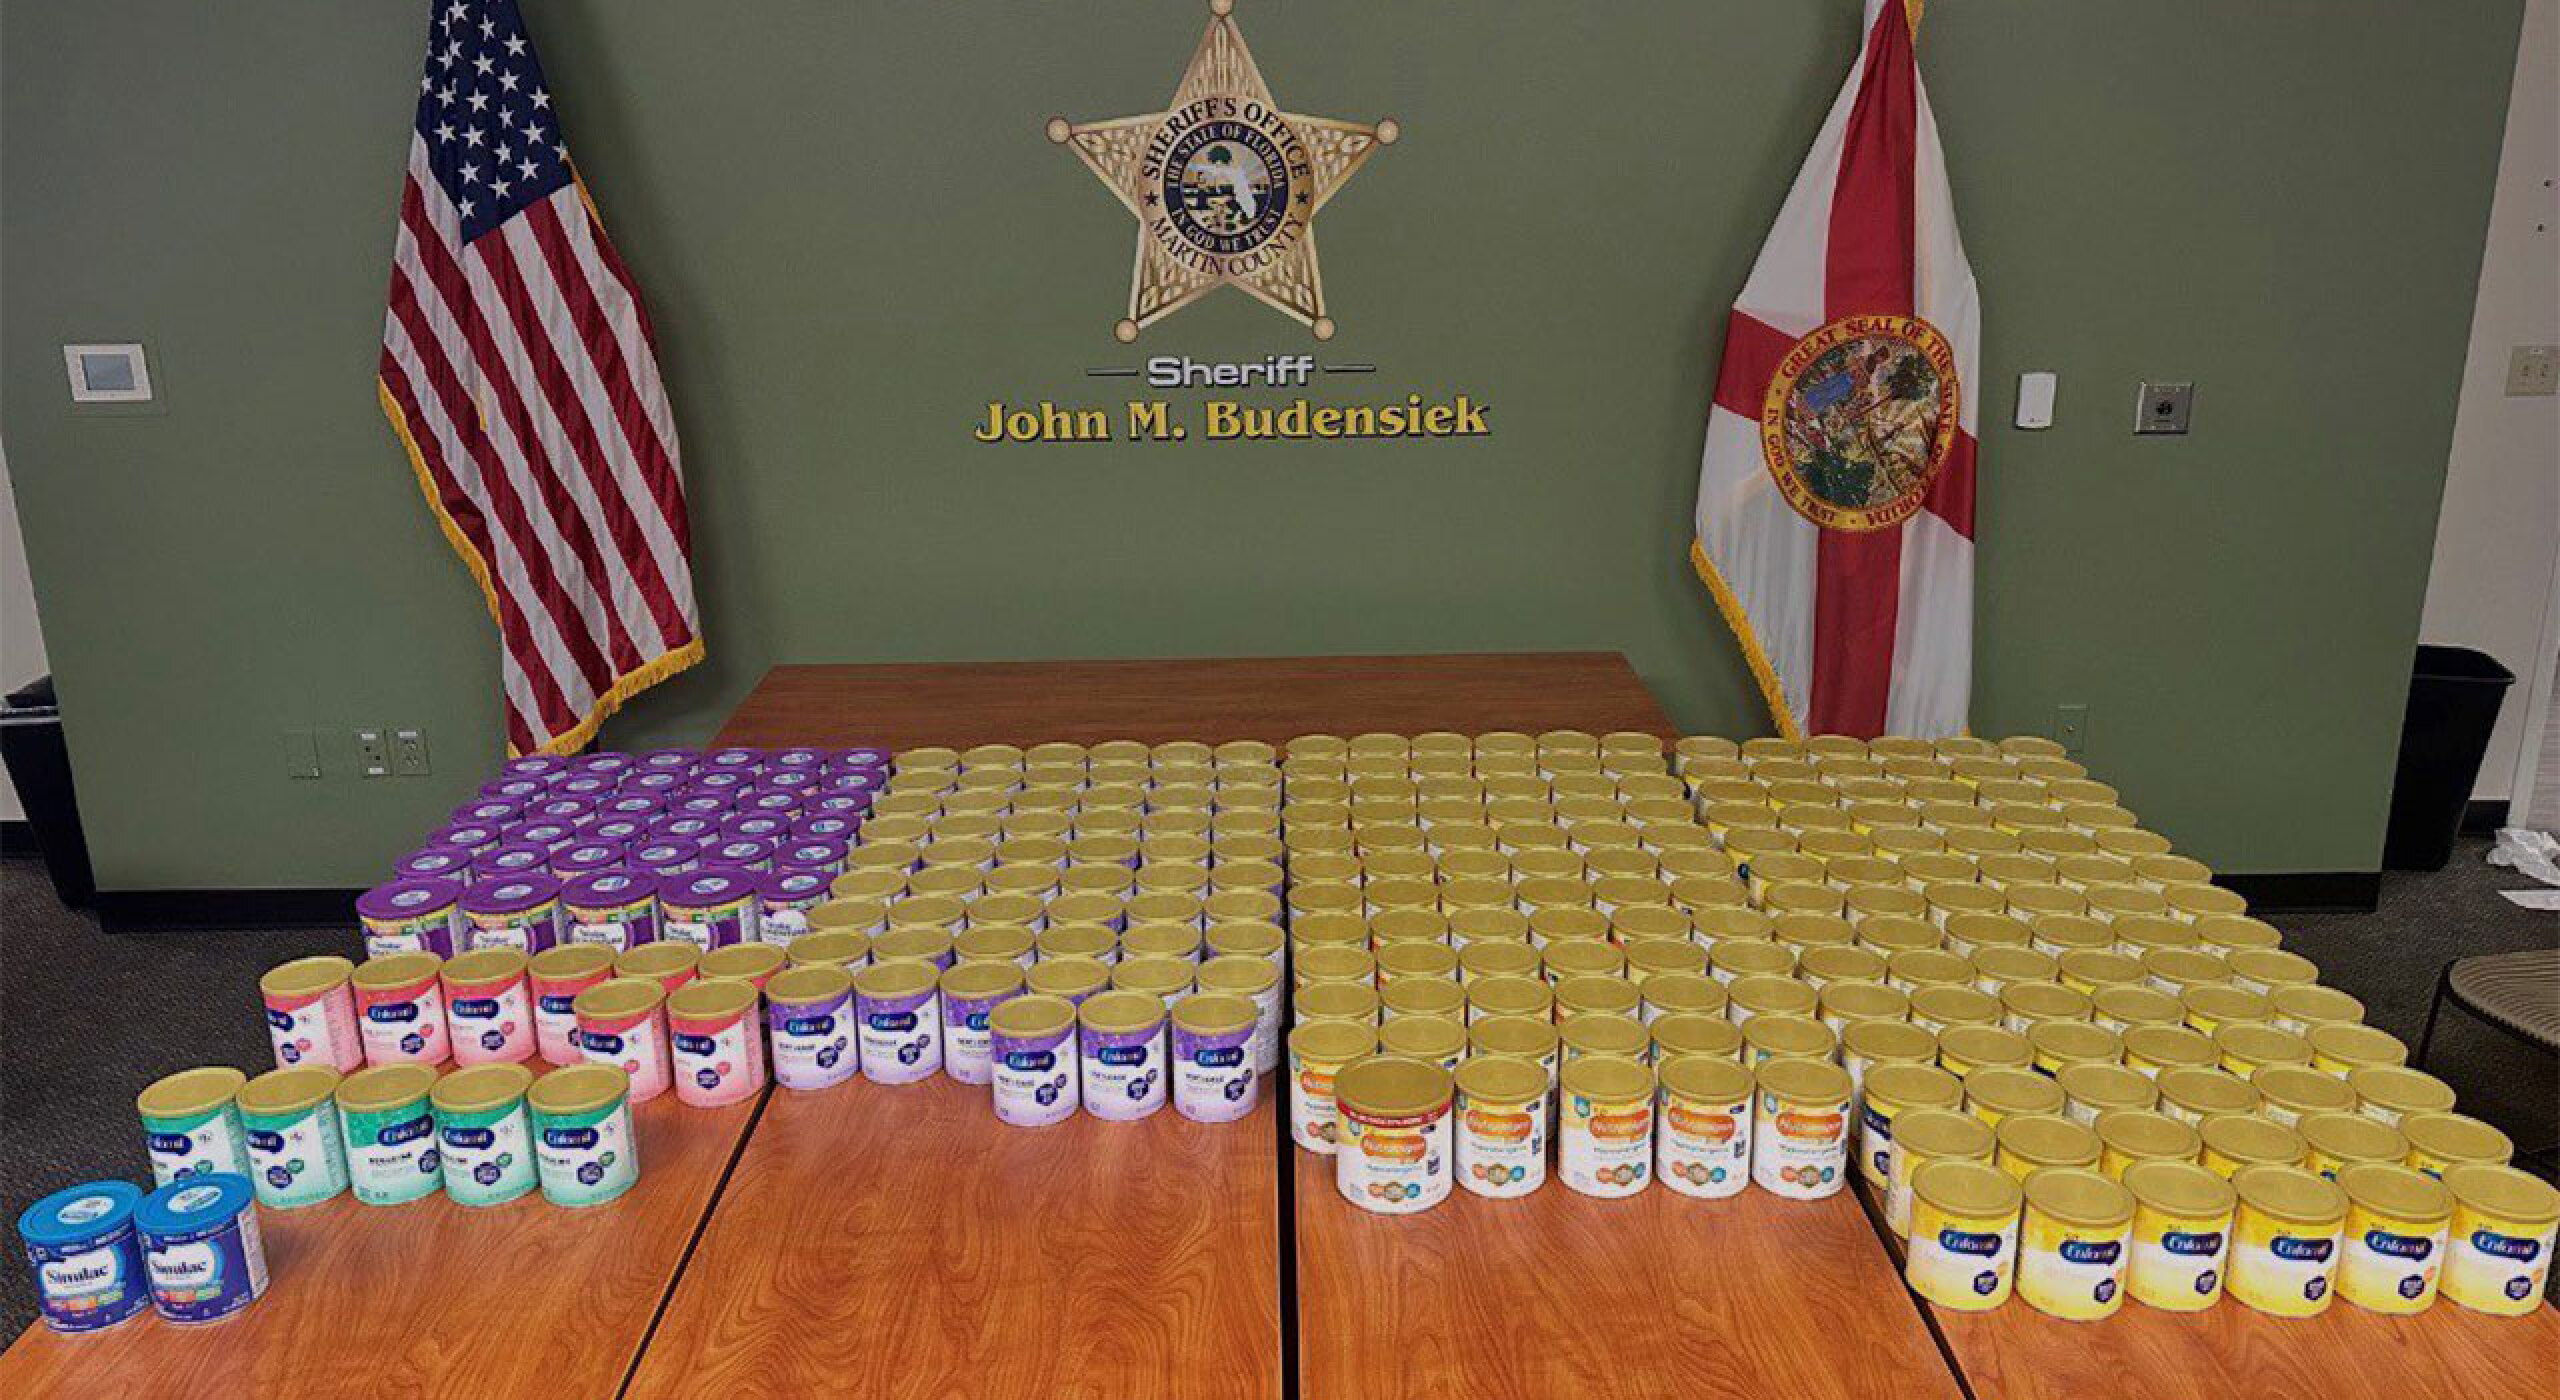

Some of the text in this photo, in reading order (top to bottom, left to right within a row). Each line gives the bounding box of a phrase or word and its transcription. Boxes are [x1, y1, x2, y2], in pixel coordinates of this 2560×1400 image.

[1142, 97, 1310, 181] SHERIFF'S OFFICE
[1221, 124, 1241, 138] OF
[1245, 131, 1286, 188] FLORIDA
[1151, 211, 1304, 276] MARTIN COUNTY
[1185, 224, 1215, 248] GOD
[1247, 208, 1281, 247] TRUST
[1781, 328, 1838, 380] GREAT
[1845, 317, 1895, 336] SEAL
[1901, 319, 1925, 340] OF
[1925, 337, 1951, 374] THE
[1146, 355, 1314, 387] Sheriff
[974, 394, 1490, 441] John M. Budensiek
[1767, 407, 1779, 426] IN
[1769, 434, 1785, 468] GOD
[1801, 497, 1837, 522] TRUST
[46, 1265, 109, 1285] Similac
